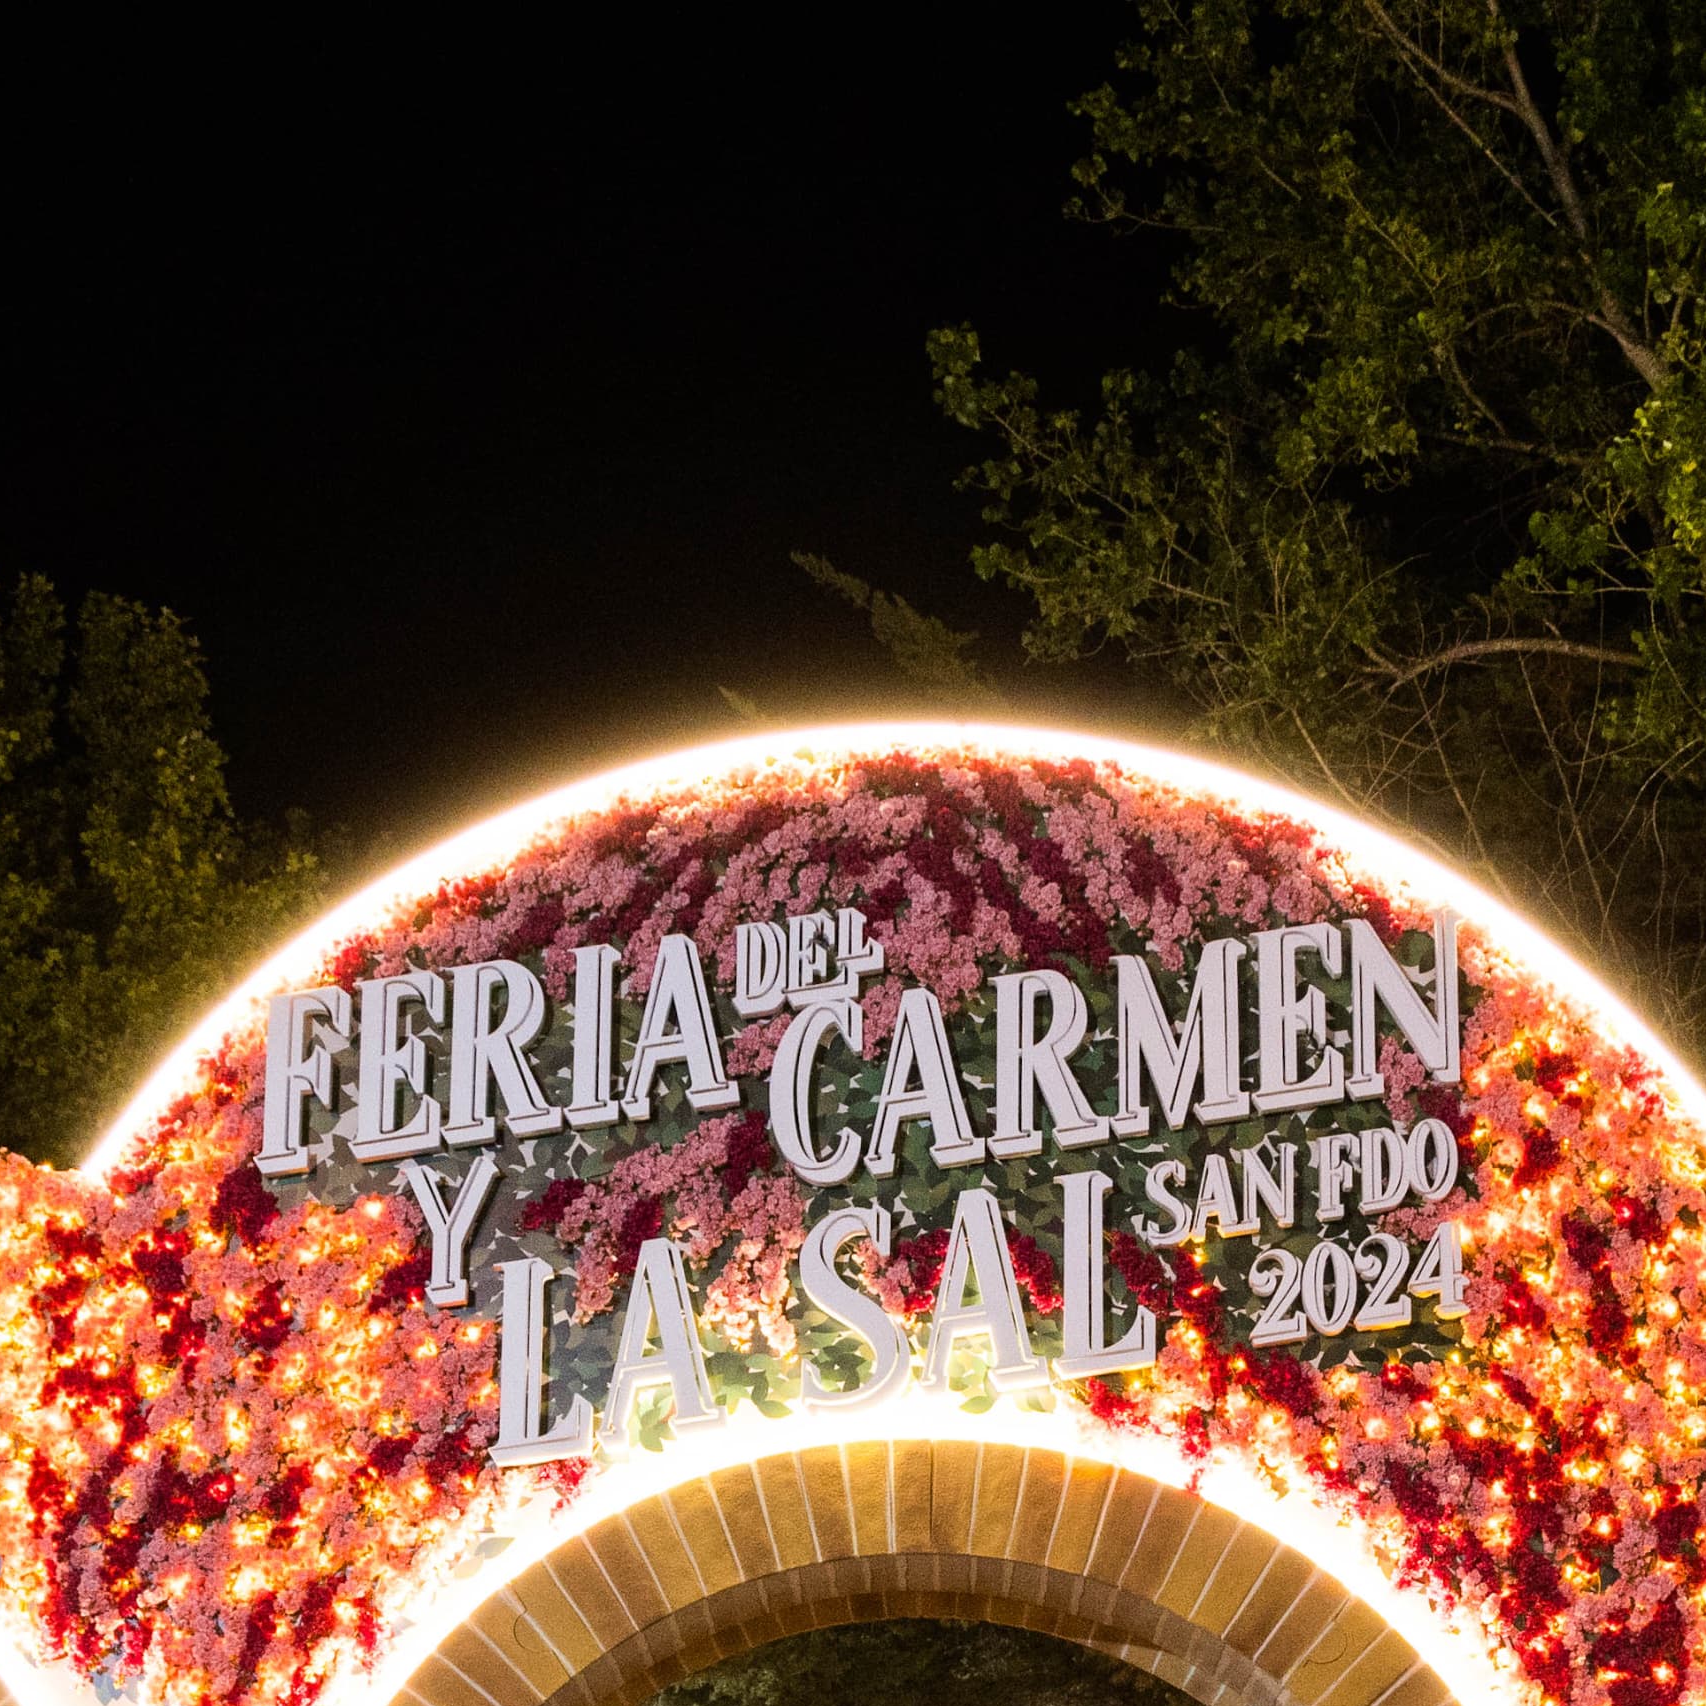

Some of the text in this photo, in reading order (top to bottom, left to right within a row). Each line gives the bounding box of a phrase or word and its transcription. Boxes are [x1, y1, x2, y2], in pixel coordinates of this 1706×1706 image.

[254, 907, 1462, 1188] FERIA DEL CARMEN
[1137, 1119, 1459, 1247] SAN FDO
[1249, 1222, 1471, 1348] 2024
[405, 1154, 1157, 1467] Y LA SAL
